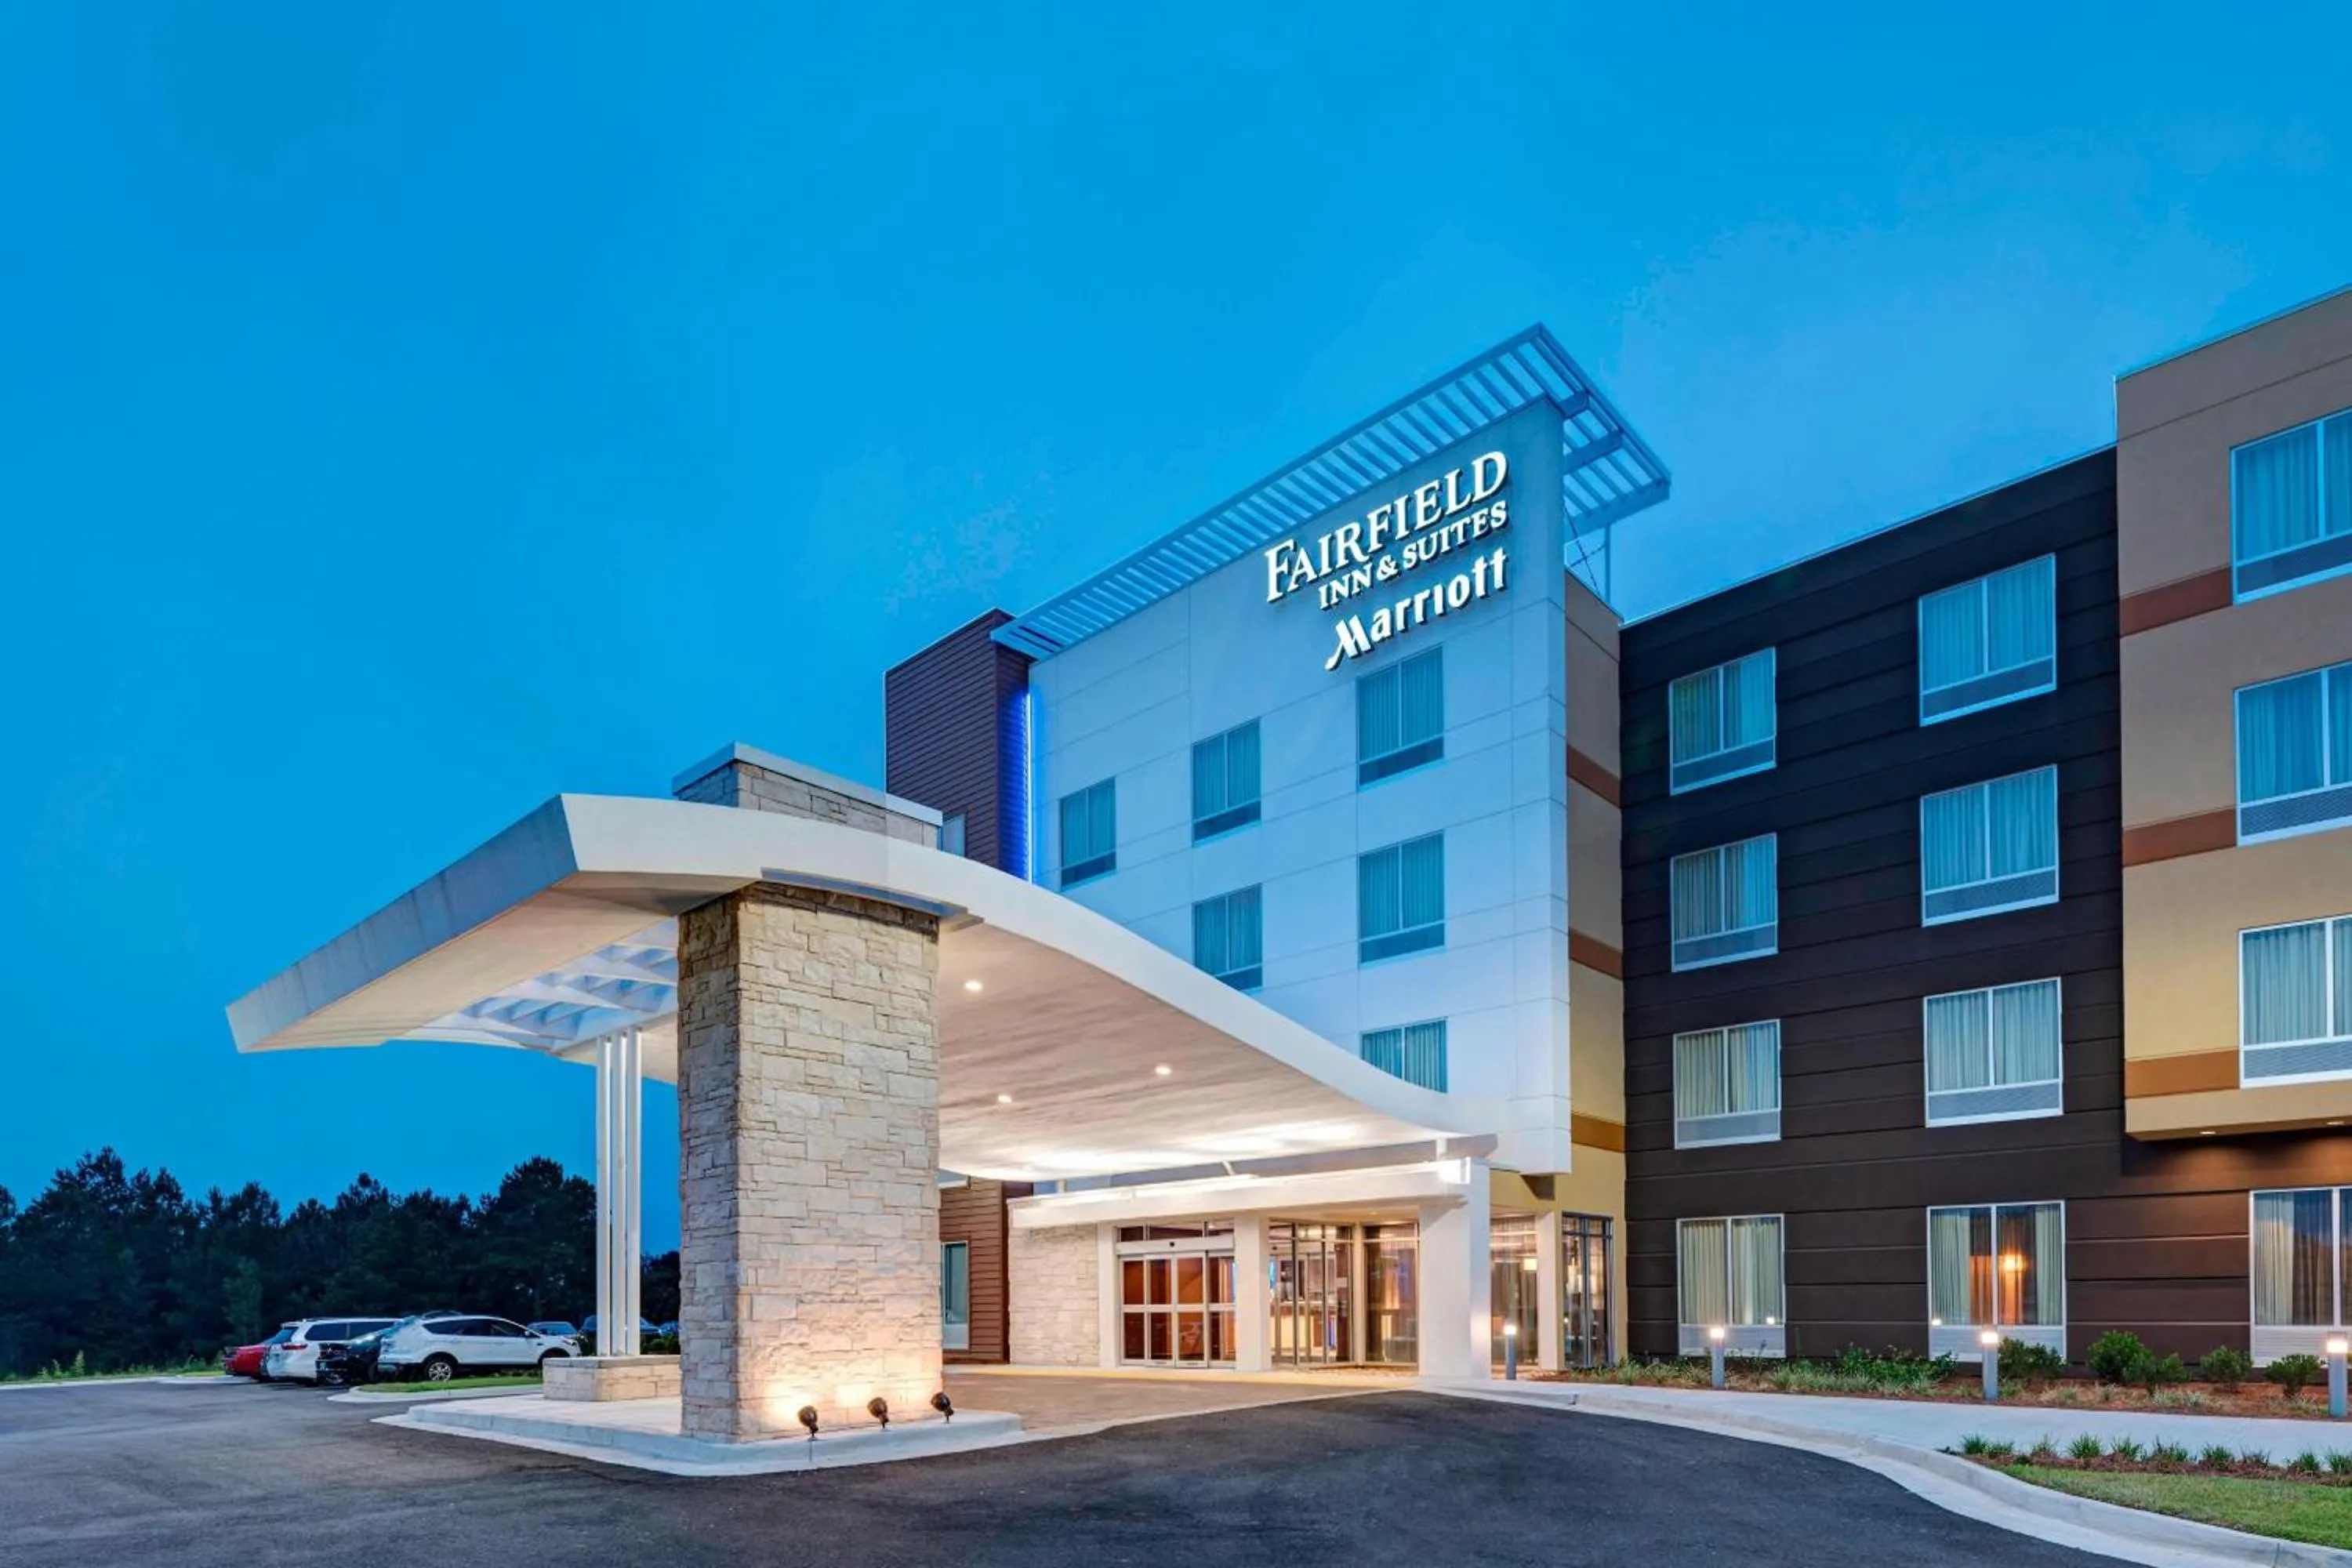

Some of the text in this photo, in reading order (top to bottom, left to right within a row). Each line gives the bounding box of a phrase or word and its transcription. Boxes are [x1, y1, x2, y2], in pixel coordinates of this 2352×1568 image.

[1264, 451, 1508, 603] FAIRFIELD
[1319, 499, 1507, 610] INN & SUITES
[1325, 546, 1507, 671] Marriott
